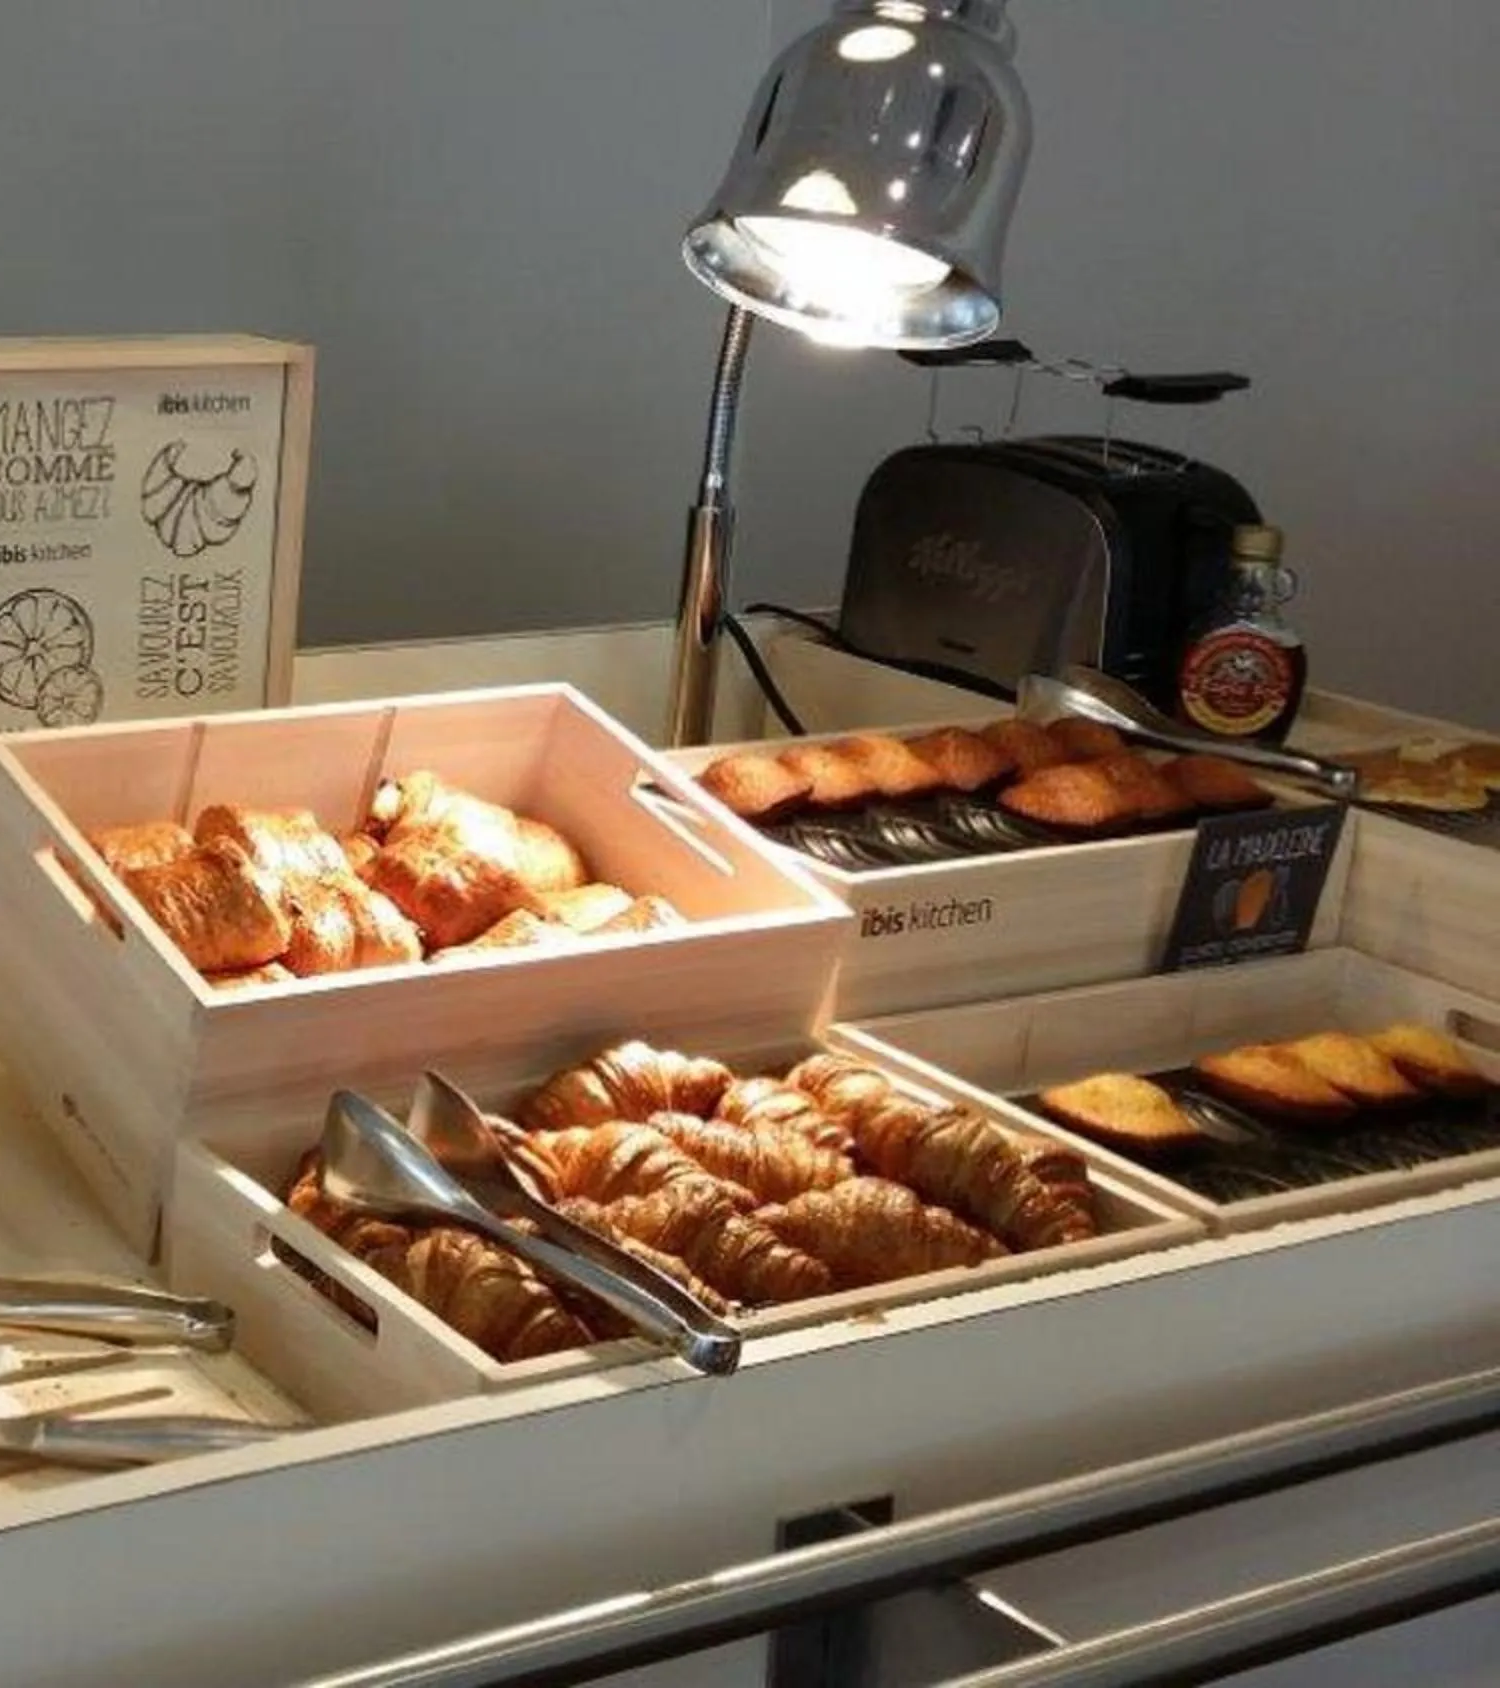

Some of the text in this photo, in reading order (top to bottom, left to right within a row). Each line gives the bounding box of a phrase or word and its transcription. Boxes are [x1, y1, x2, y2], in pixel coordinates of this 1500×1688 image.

[174, 573, 210, 698] C'EST
[861, 896, 993, 938] ibis kitchen
